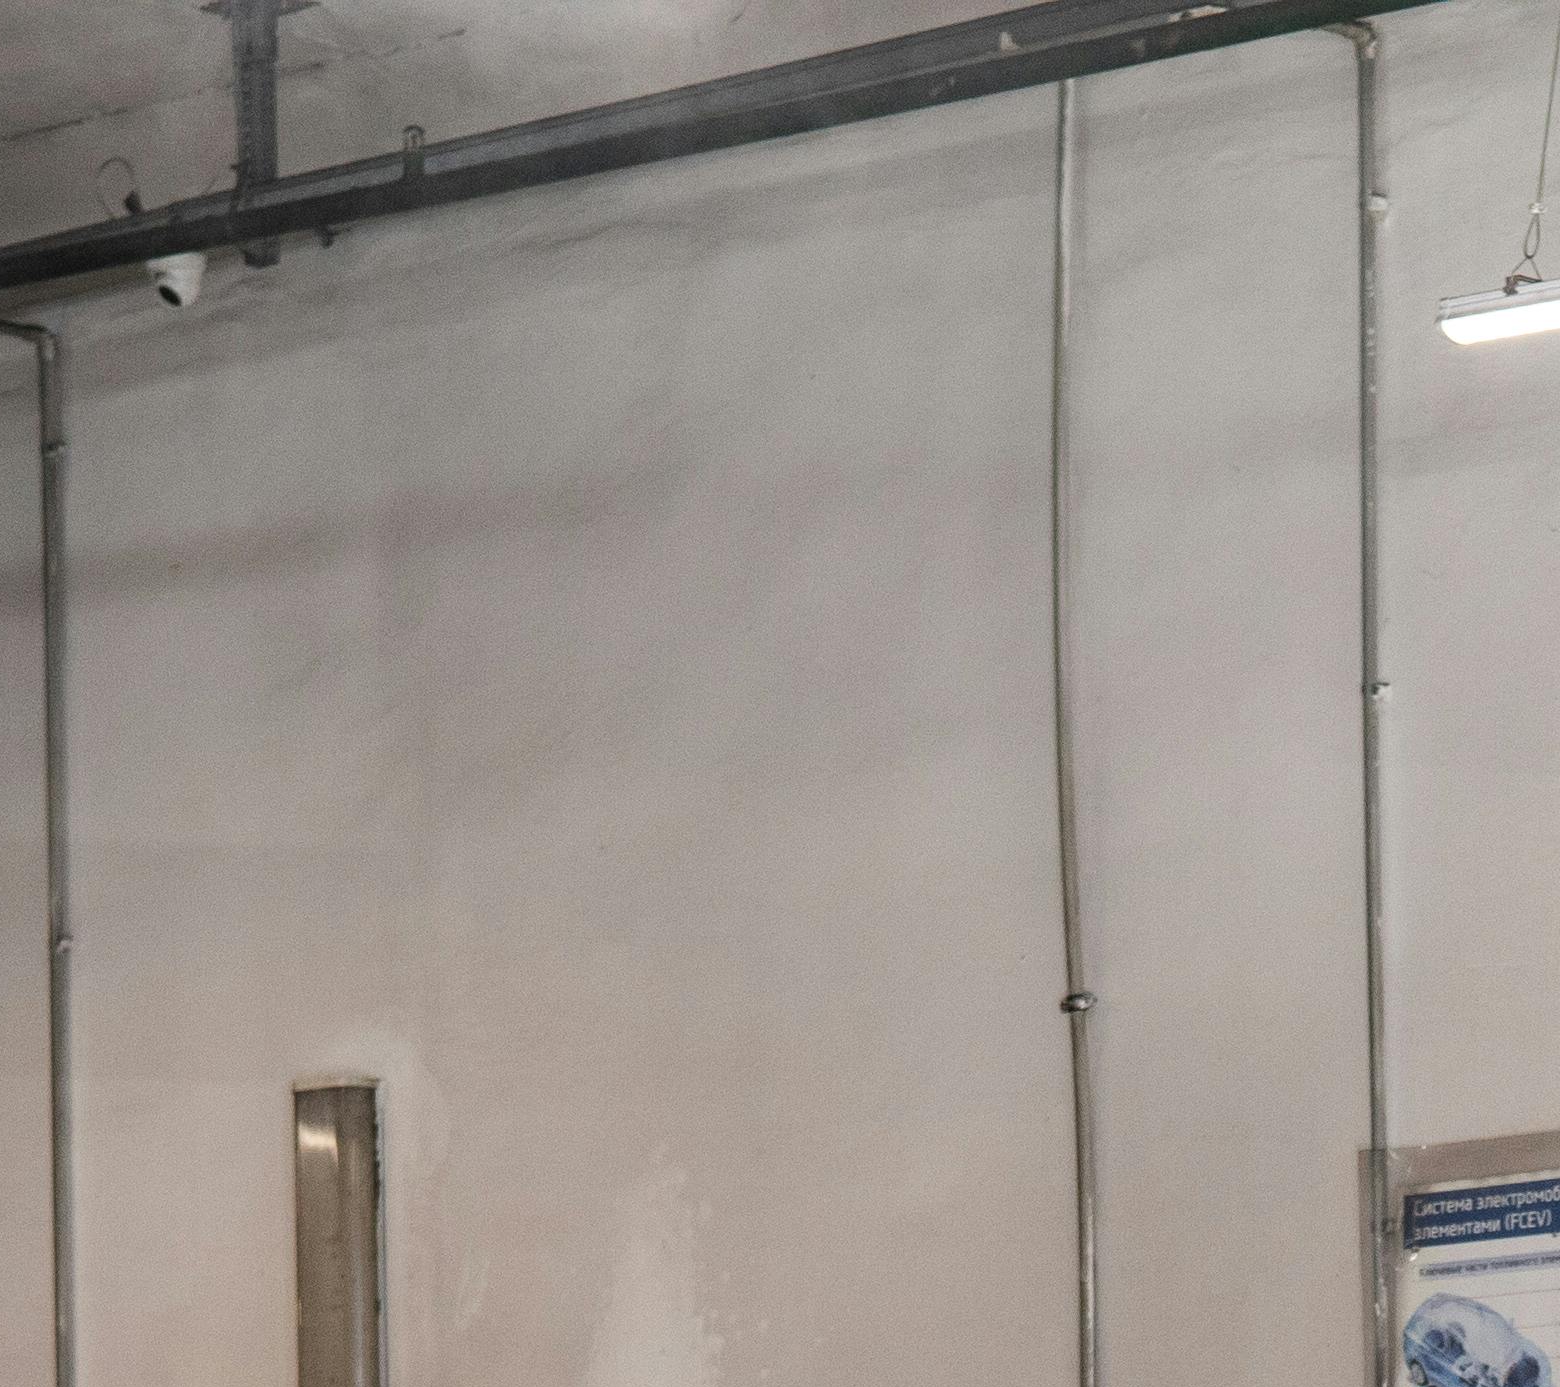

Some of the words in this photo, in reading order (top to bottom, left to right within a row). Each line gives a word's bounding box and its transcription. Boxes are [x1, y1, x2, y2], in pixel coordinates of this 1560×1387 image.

[1414, 1198, 1473, 1218] Система
[1414, 1221, 1501, 1241] элементами
[1504, 1209, 1553, 1232] (FCEV)
